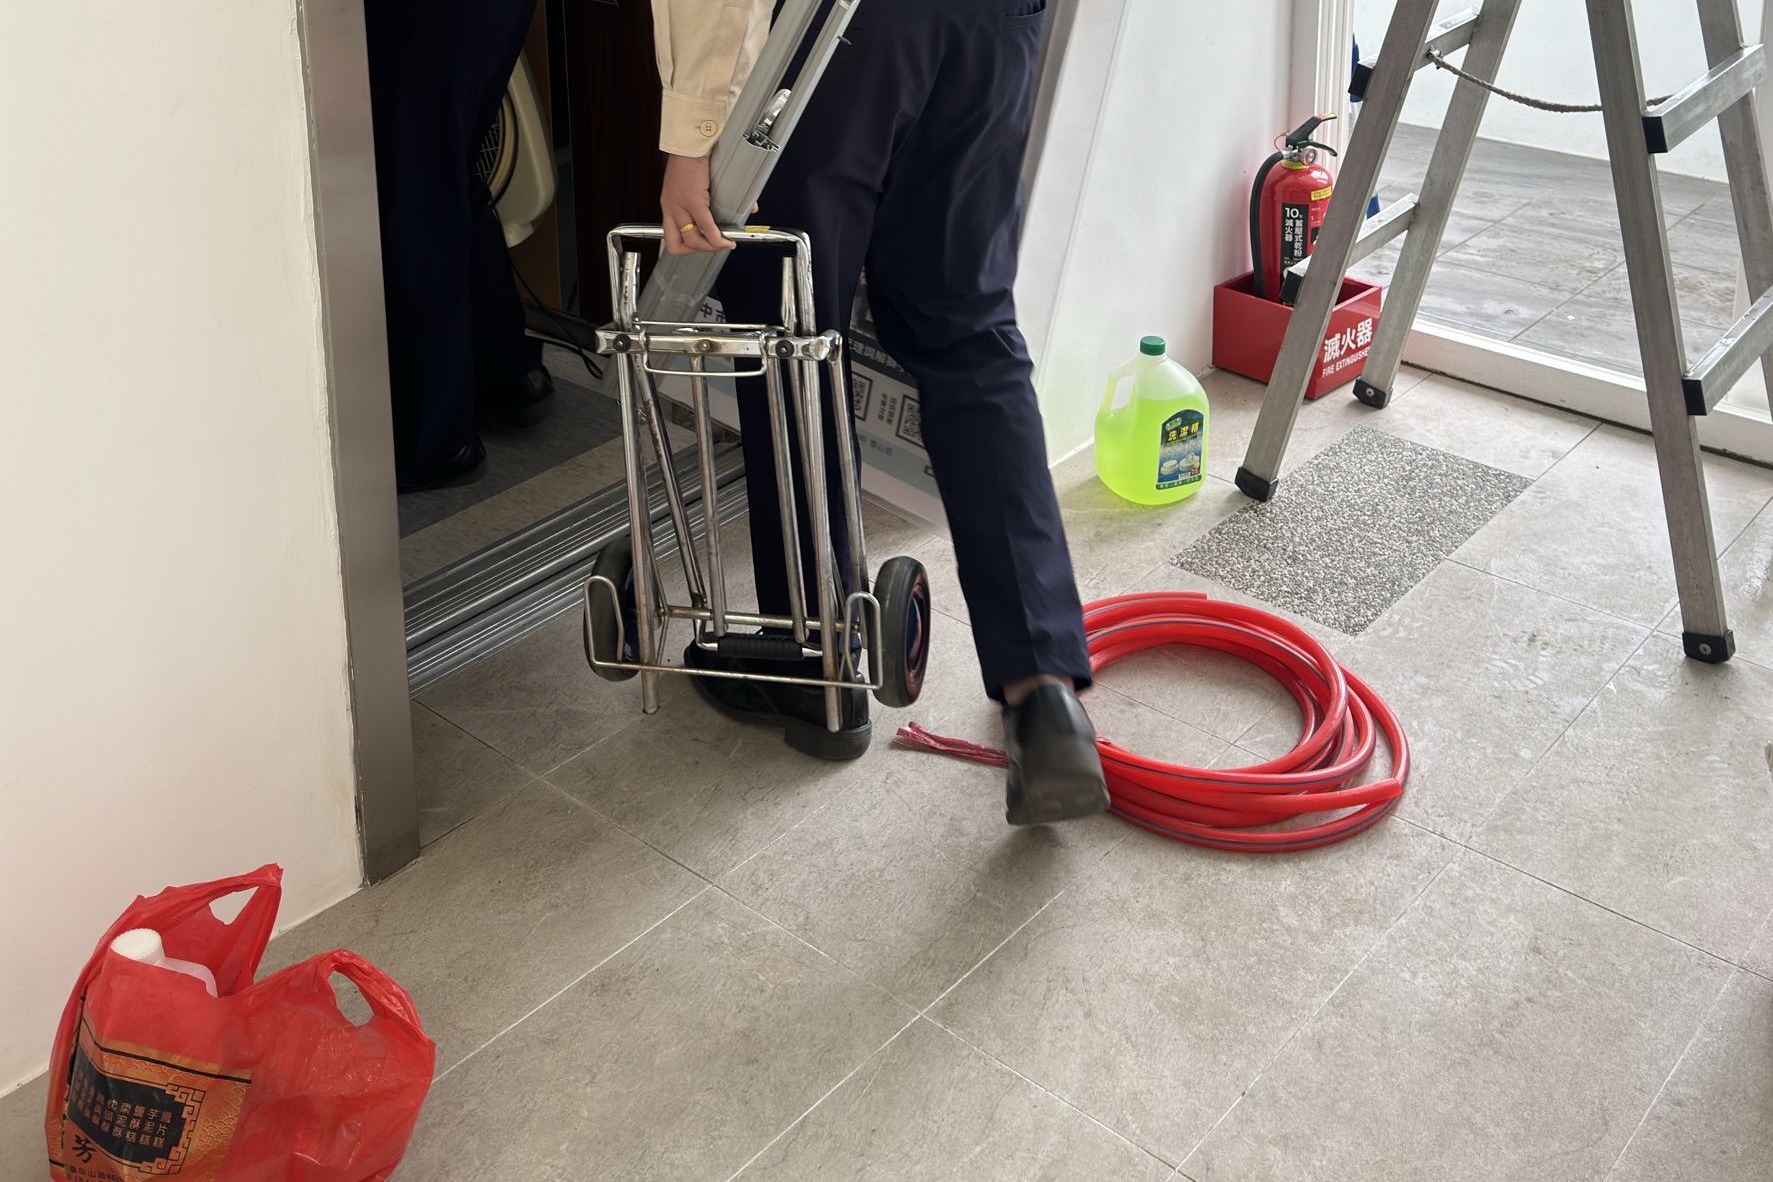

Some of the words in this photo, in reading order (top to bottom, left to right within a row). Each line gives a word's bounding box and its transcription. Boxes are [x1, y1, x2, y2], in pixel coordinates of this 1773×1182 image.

[1323, 317, 1373, 364] 滅火器
[1322, 364, 1335, 378] FIRE
